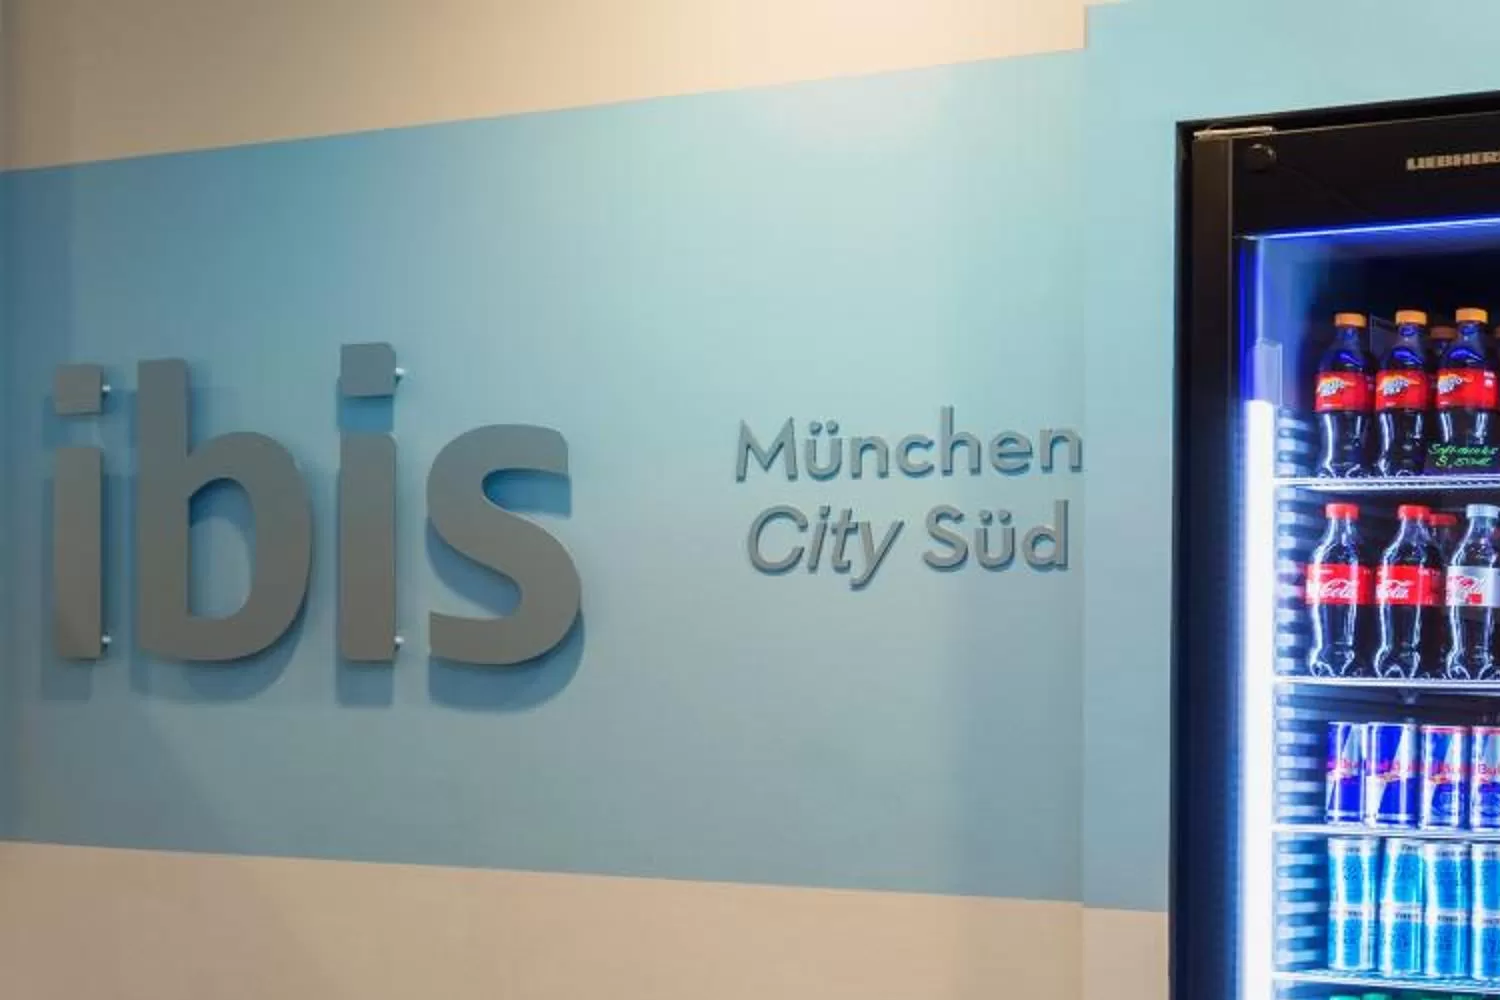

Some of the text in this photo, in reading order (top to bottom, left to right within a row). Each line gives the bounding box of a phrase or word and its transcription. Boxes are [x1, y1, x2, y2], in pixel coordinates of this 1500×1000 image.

[736, 406, 1084, 483] München
[53, 341, 583, 666] ibis
[746, 500, 1070, 588] City Süd
